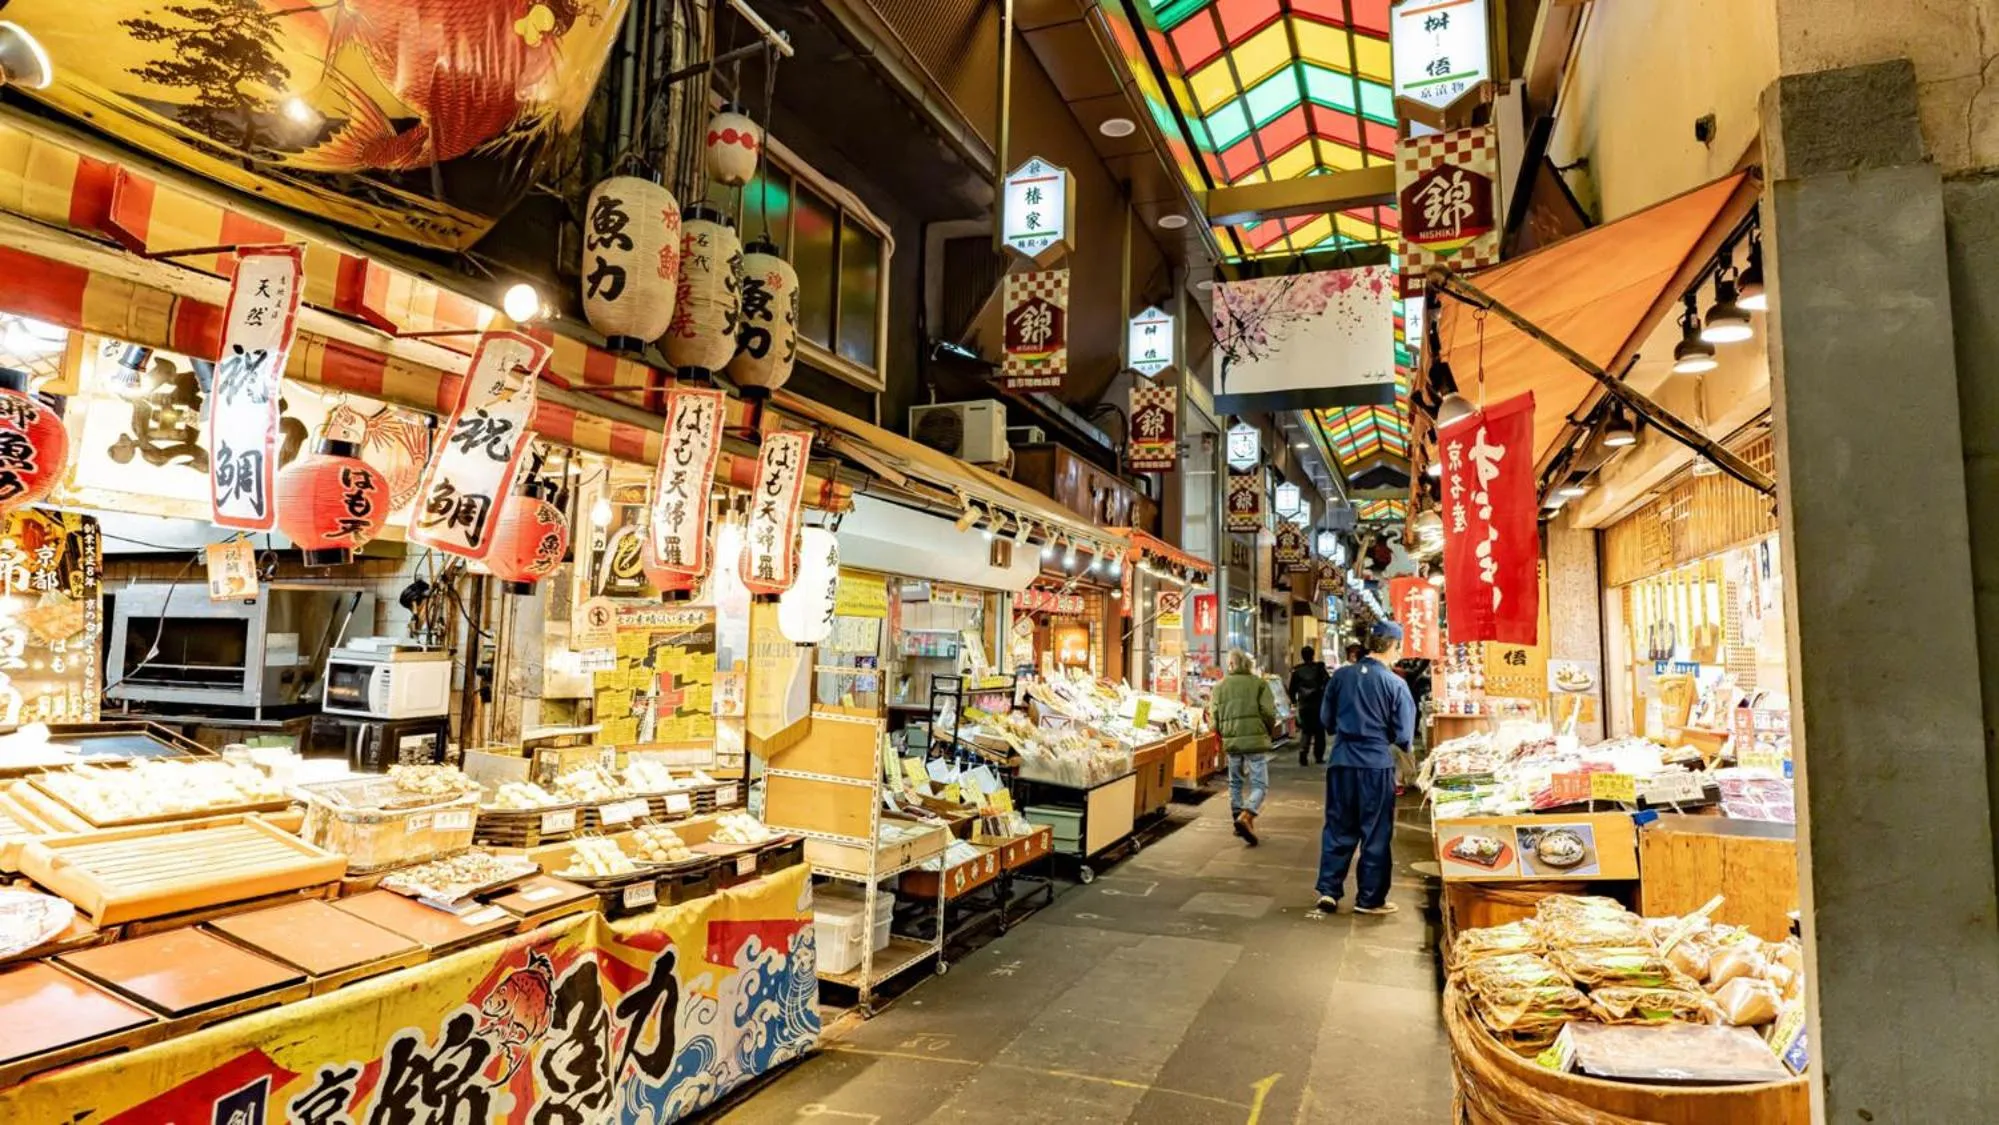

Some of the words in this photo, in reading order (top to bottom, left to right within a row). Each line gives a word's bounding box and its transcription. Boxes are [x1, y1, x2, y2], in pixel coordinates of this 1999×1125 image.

[1025, 186, 1043, 230] 椿家
[1412, 170, 1475, 237] 錦
[1419, 228, 1455, 239] NISHIKI
[587, 195, 634, 302] 魚力
[244, 277, 271, 327] 天然
[735, 275, 775, 359] 魚力
[1012, 302, 1053, 352] 錦
[215, 342, 269, 518] 祝鯛
[1135, 407, 1166, 442] 錦
[416, 406, 513, 548] 祝鯛
[662, 402, 705, 567] はも天婦羅
[755, 441, 791, 581] はも天婦羅
[33, 543, 61, 592] 京都
